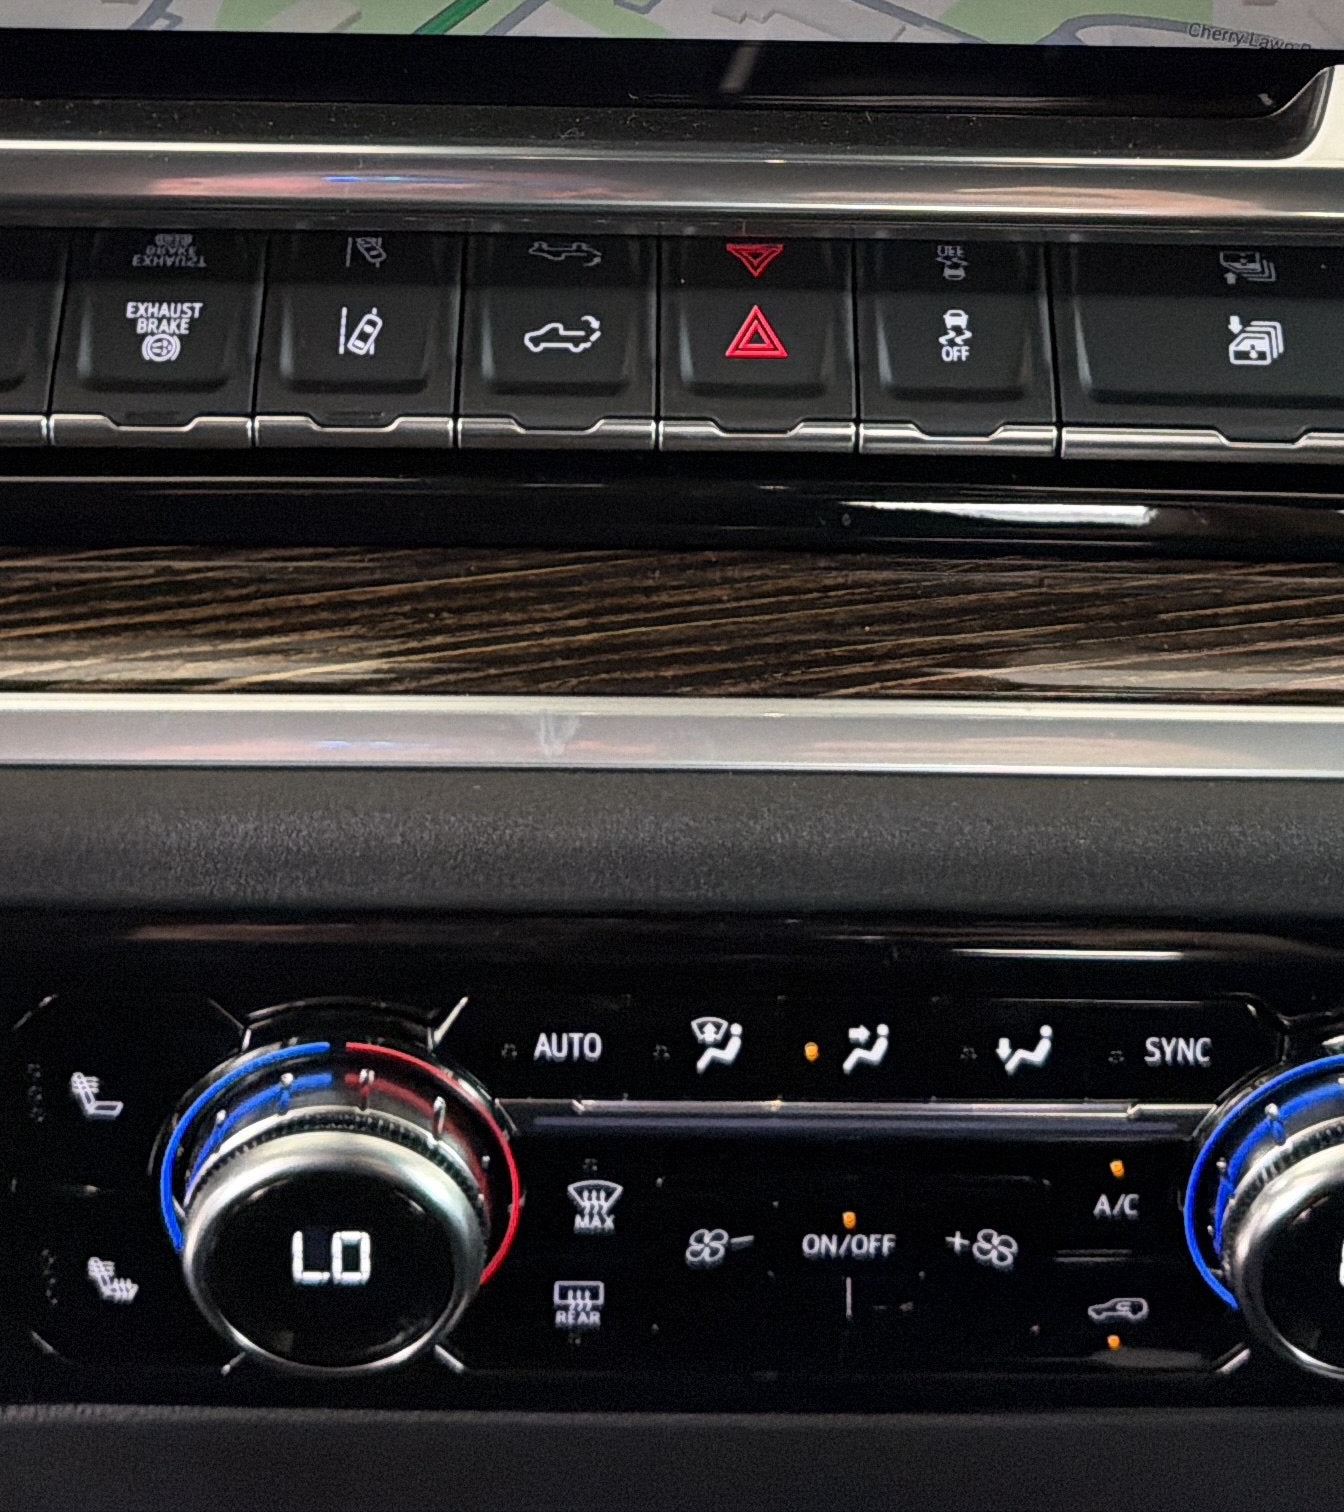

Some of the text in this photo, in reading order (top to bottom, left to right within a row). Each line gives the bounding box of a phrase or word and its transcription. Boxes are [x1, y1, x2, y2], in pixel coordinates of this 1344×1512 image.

[1187, 22, 1245, 48] Cherry
[125, 301, 204, 319] EXHAUST
[136, 318, 191, 335] BRAKE
[941, 346, 971, 362] OFF
[533, 1032, 603, 1062] AUTO
[1143, 1036, 1213, 1066] SYNC
[1093, 1193, 1141, 1219] A/C
[573, 1214, 616, 1233] MAX
[291, 1230, 371, 1285] LO
[801, 1232, 897, 1259] ON/OFF
[554, 1310, 601, 1328] REAR
